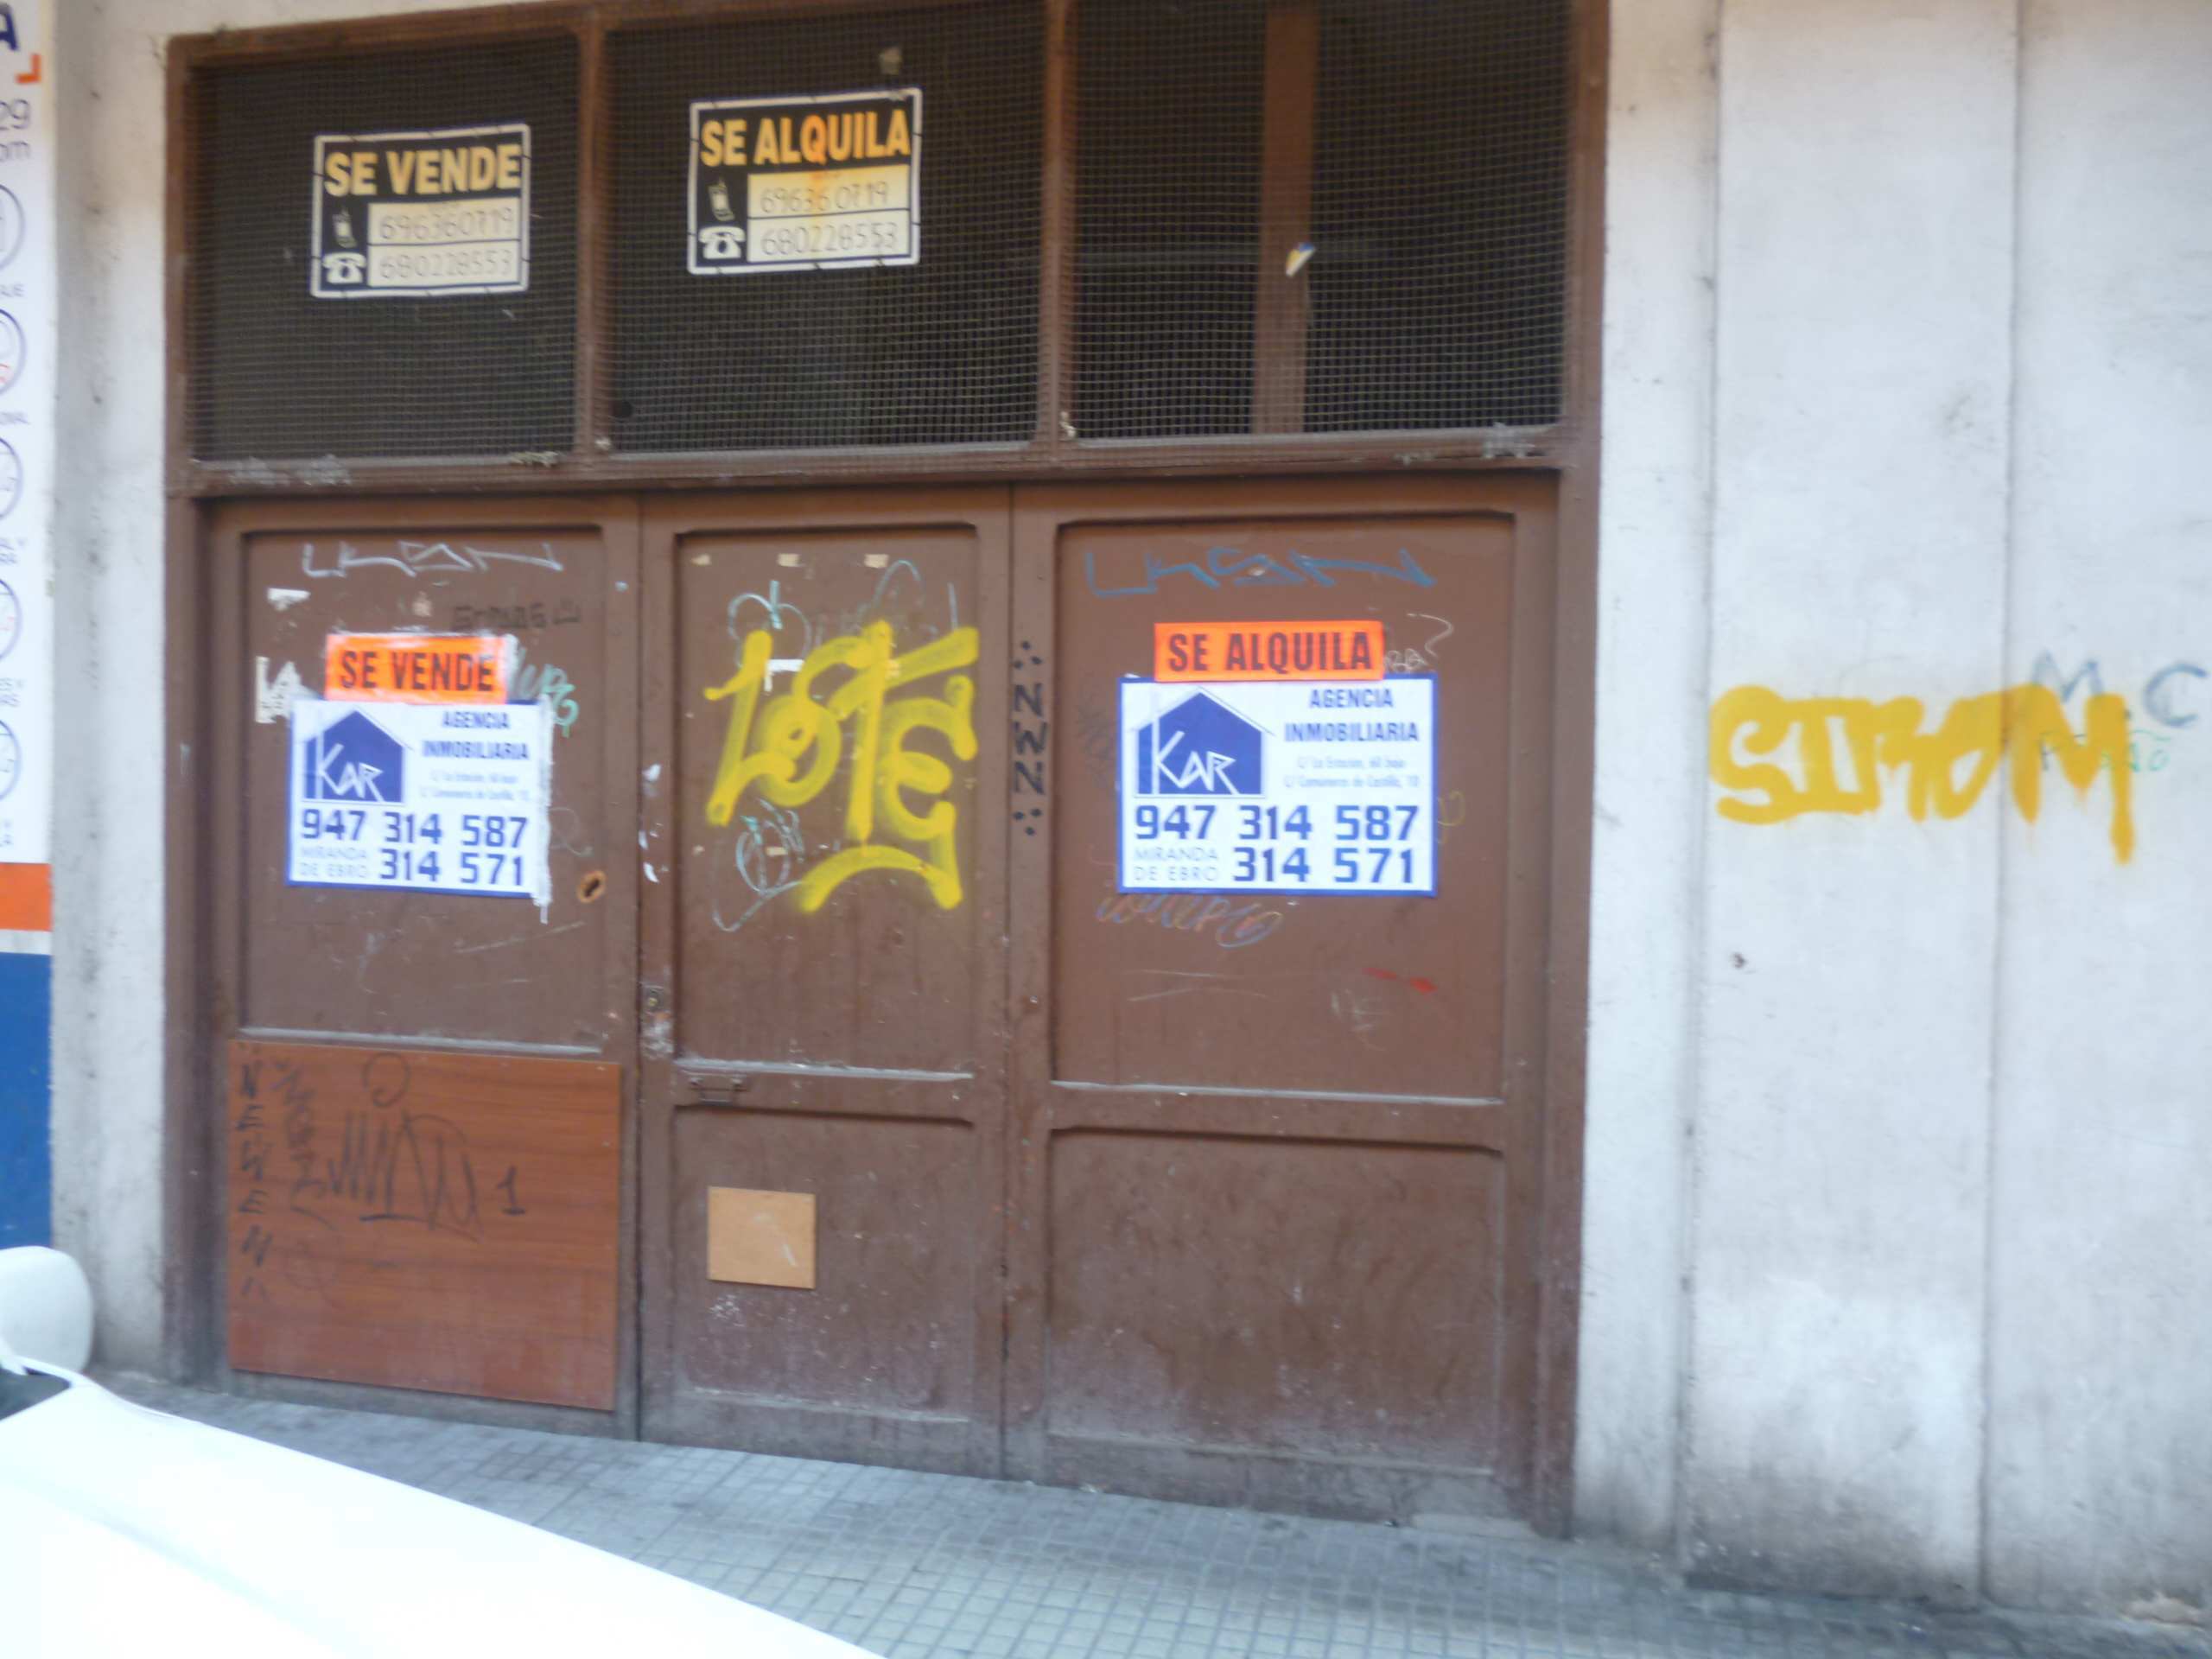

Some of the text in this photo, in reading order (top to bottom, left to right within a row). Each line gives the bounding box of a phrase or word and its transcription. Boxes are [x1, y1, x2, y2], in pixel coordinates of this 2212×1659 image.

[701, 108, 912, 168] SE ALQUILA
[323, 143, 522, 198] SE VENDE
[340, 650, 378, 690] SE
[391, 651, 494, 692] VENDE
[1168, 632, 1208, 672] SE
[1225, 631, 1373, 675] ALQUILA
[1309, 688, 1394, 709] AGENCIA
[442, 710, 510, 729] AGENCIA
[1285, 721, 1420, 742] INMOBILIARIA
[423, 740, 530, 760] INMOBILIARIA
[302, 808, 529, 849] 947 314 587
[1135, 804, 1420, 842] 947 314 587
[379, 848, 524, 887] 314 571
[1134, 846, 1218, 862] MIRANDA
[1232, 846, 1414, 884] 314 571
[1134, 866, 1218, 882] DE EBRO
